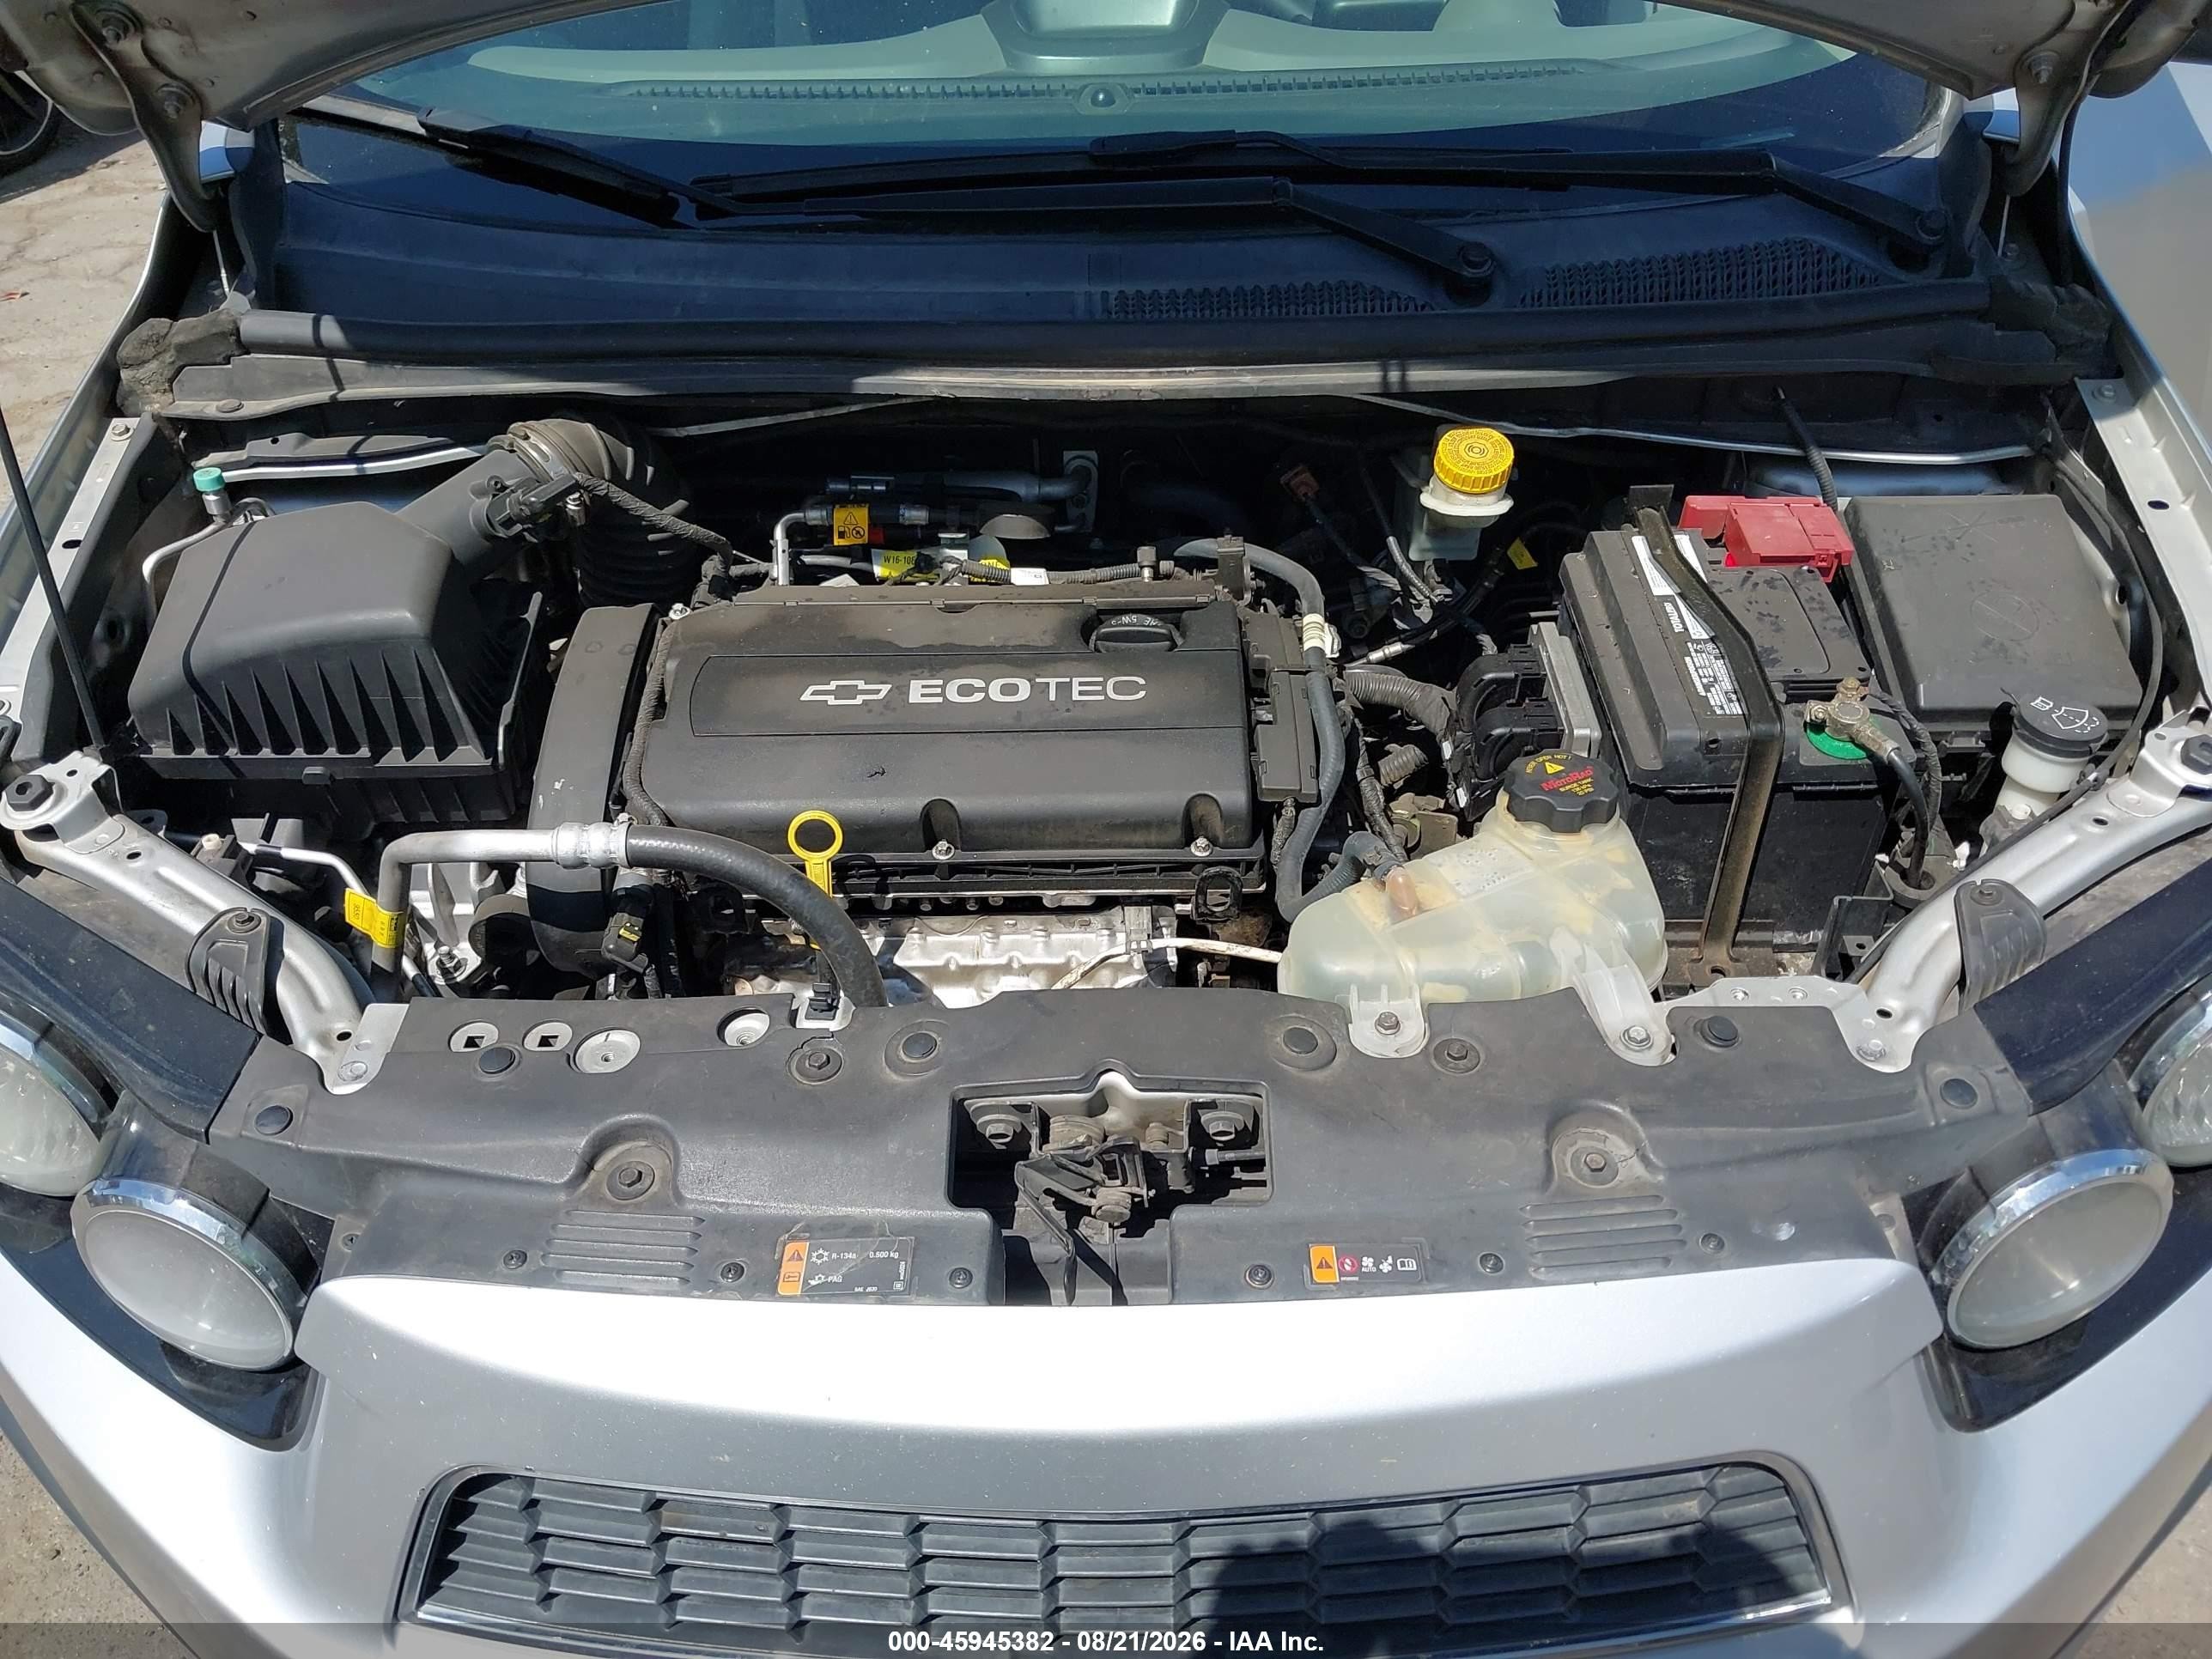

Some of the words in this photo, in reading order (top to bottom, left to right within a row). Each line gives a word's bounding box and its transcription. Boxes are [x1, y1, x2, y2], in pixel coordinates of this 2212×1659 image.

[908, 676, 1148, 704] ECOTEC
[869, 1250, 889, 1259] 0.500
[889, 1251, 899, 1260] kg
